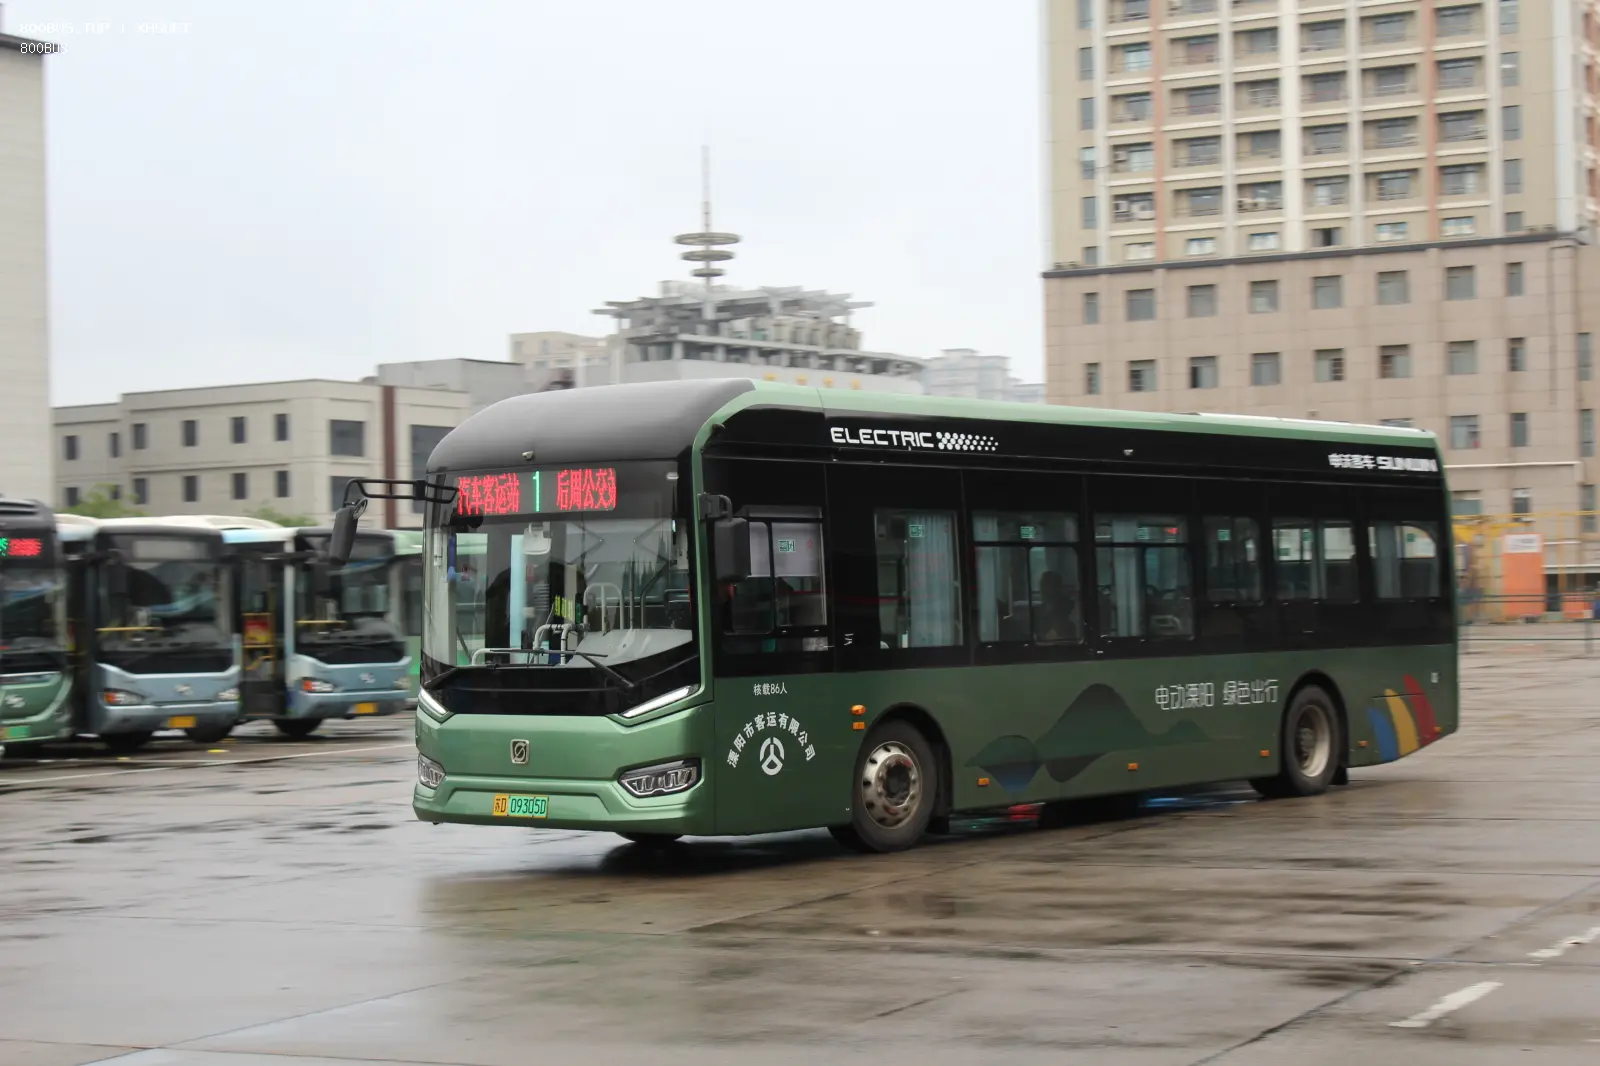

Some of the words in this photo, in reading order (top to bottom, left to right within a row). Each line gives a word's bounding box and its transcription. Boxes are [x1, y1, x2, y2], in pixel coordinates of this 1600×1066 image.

[830, 427, 934, 448] ELECTRIC
[458, 472, 520, 516] 汽车客运站
[533, 470, 540, 512] 1
[753, 682, 788, 696] 核载86人
[1222, 679, 1279, 706] 绿色出行
[726, 711, 816, 768] 溧阳市客运有限公司
